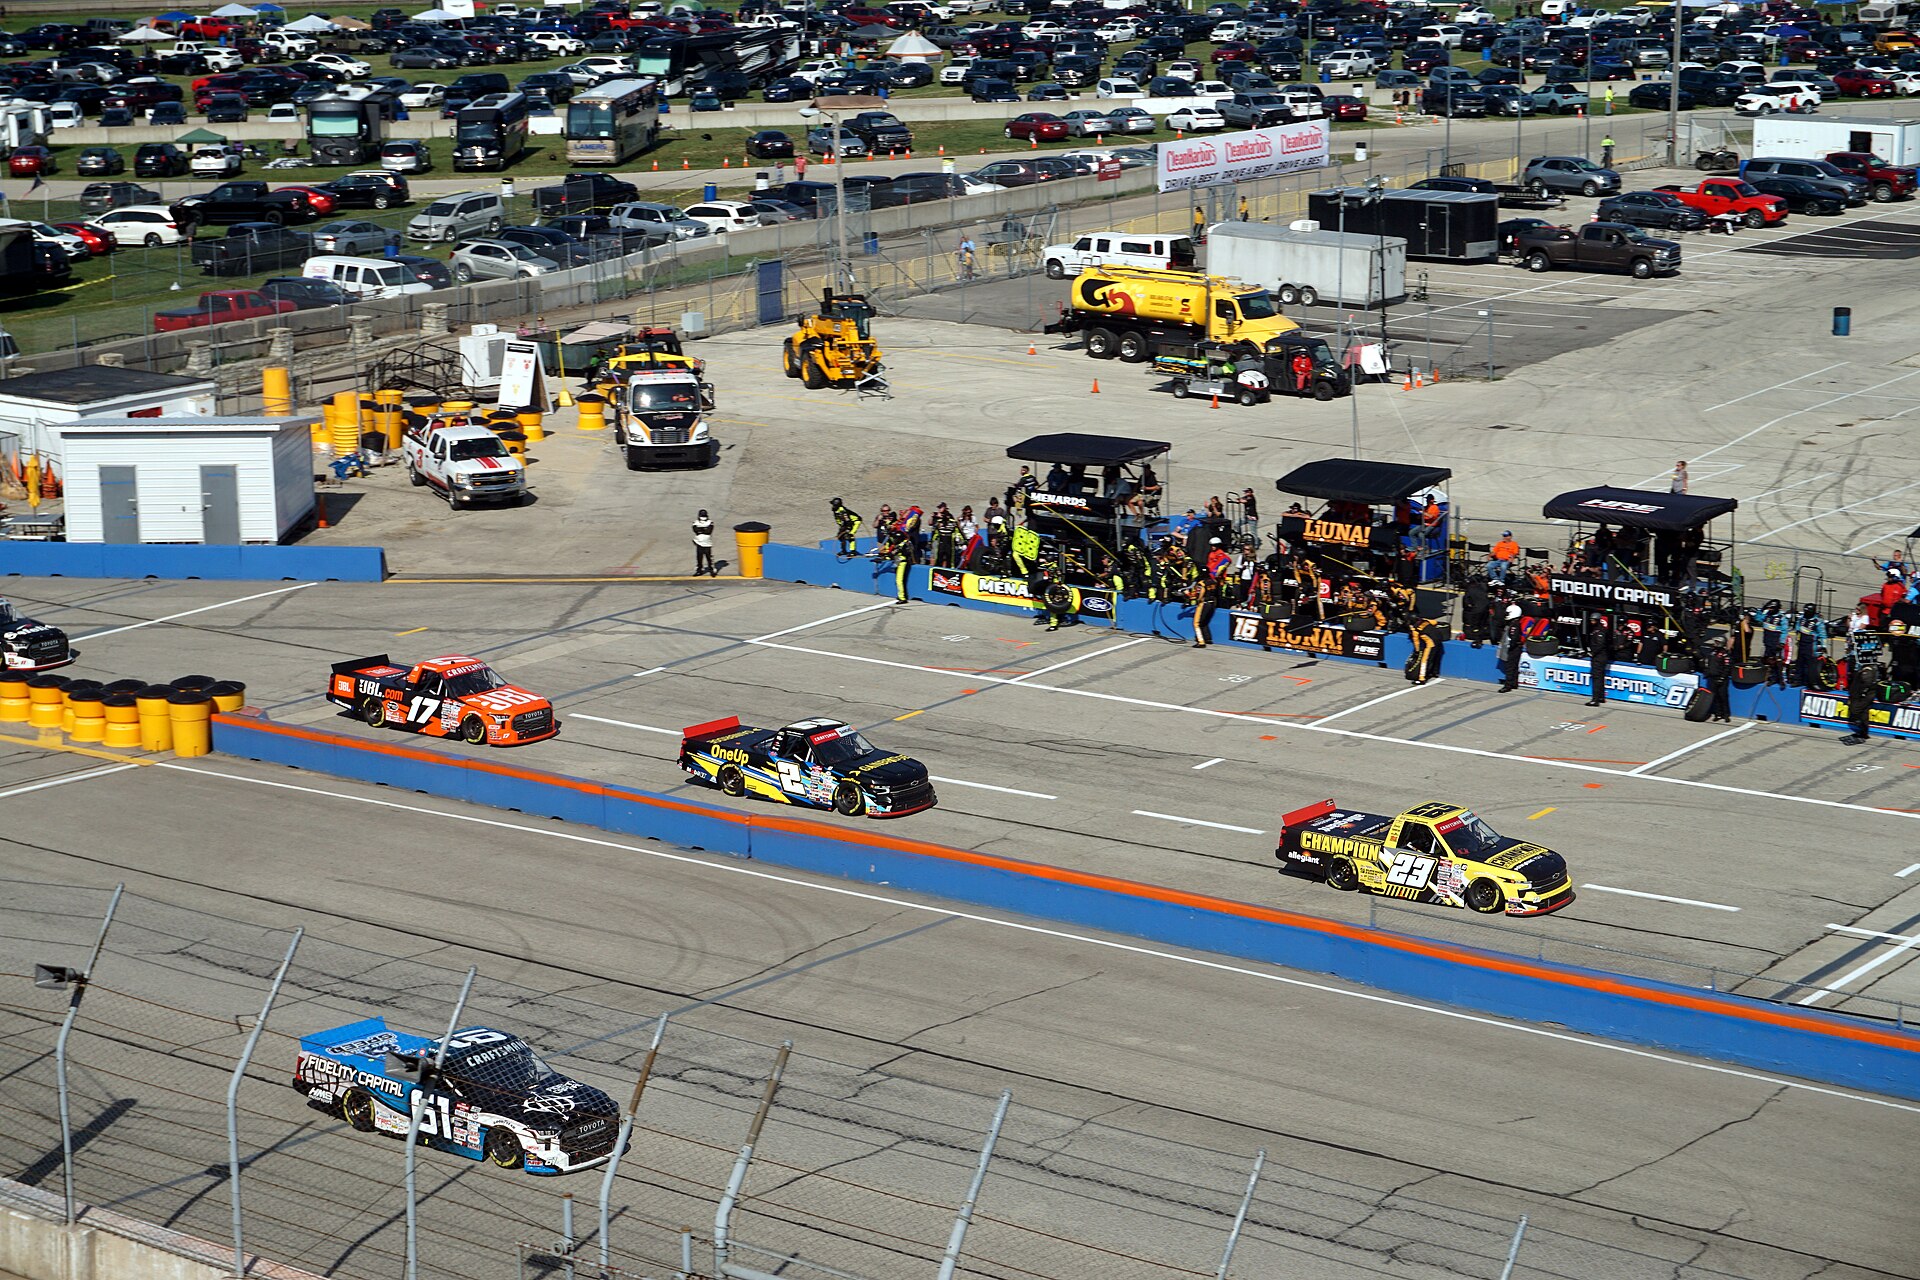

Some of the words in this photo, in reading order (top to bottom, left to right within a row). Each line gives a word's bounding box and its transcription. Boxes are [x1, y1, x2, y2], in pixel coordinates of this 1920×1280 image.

[1225, 139, 1272, 163] CleanHarbors
[1281, 131, 1323, 154] CleanHarbors
[1166, 147, 1218, 172] CleanHarbors
[1252, 164, 1274, 174] BEST
[1306, 155, 1325, 166] BEST
[1197, 172, 1219, 183] BEST
[1030, 492, 1087, 507] MENARDS
[1580, 498, 1666, 512] HRE
[1303, 519, 1371, 543] LiUNA!
[1552, 579, 1613, 599] FIDELITY
[1614, 587, 1674, 607] CAPITAL
[1233, 617, 1259, 639] 16
[338, 681, 351, 692] JBL
[1545, 668, 1592, 686] FIDELIT
[407, 695, 441, 724] 17
[525, 711, 543, 719] TOYOTA
[711, 744, 749, 767] OneUp
[777, 761, 807, 796] 2
[1288, 851, 1320, 865] allegiant
[1301, 831, 1381, 862] CHAMPION
[1386, 851, 1437, 889] 23
[466, 1039, 529, 1067] CRAFTSMAN
[308, 1055, 357, 1082] FIDELITY
[357, 1071, 404, 1097] CAPITAL
[411, 1089, 452, 1140] 61
[579, 1120, 605, 1133] TOYOTA
